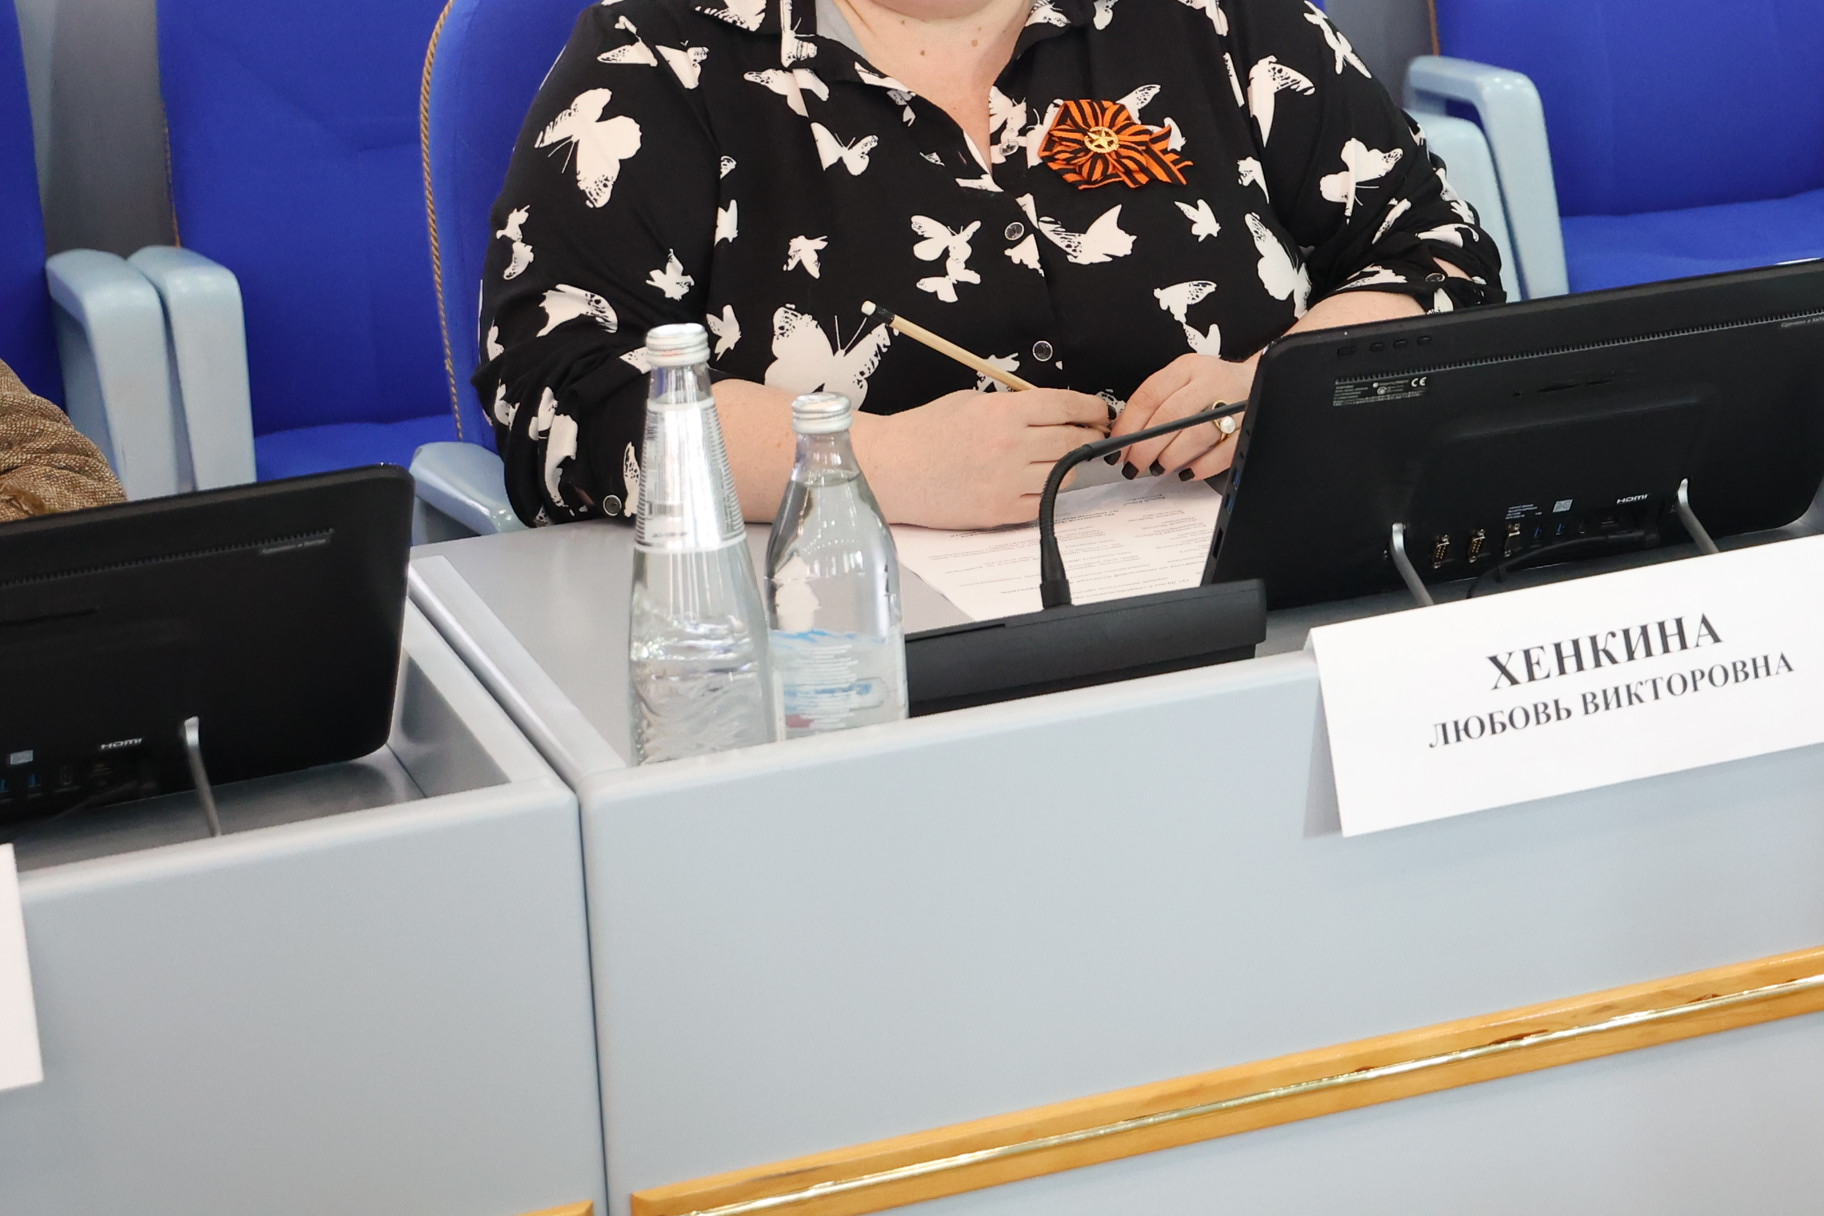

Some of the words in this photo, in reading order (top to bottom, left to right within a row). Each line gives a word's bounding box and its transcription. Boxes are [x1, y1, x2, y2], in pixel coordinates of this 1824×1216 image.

[1410, 376, 1427, 388] CE
[1616, 493, 1649, 505] HDMI
[1487, 613, 1723, 690] ХЕНКИНА
[1428, 698, 1573, 748] ЛЮБОВЬ
[1581, 652, 1794, 715] ВИКТОРОВНА
